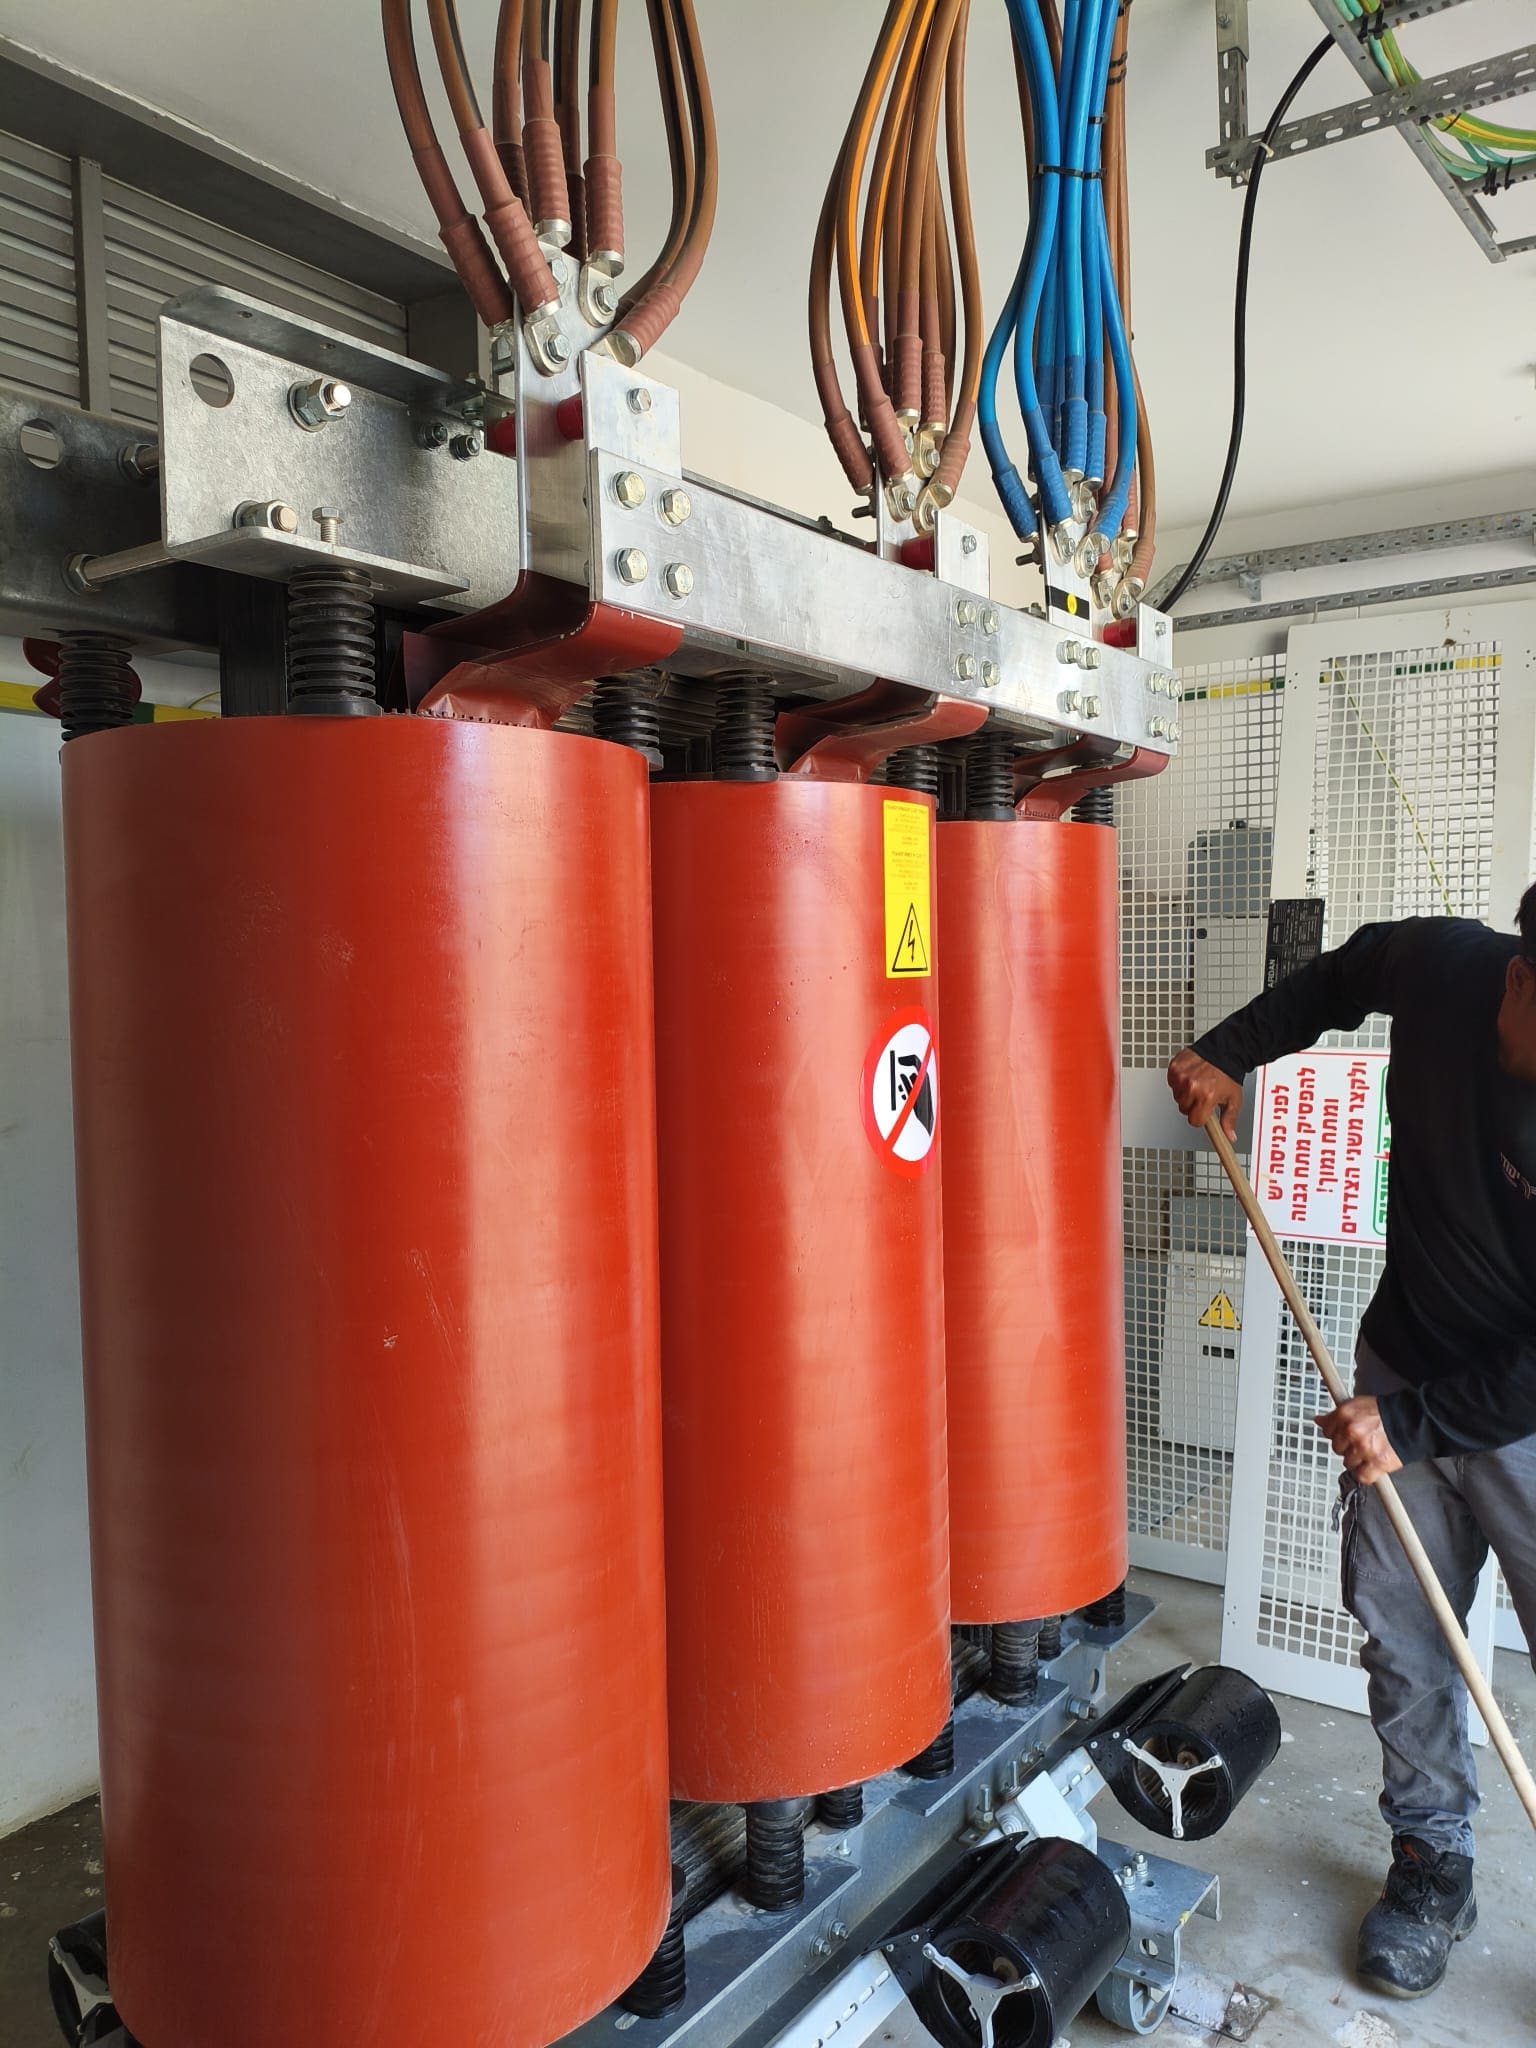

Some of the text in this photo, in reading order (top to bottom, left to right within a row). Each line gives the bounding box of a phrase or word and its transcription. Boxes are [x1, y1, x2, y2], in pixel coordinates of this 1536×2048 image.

[1267, 959, 1275, 988] ARDAN
[1267, 1084, 1290, 1200] לפני כניסה יש
[1290, 1066, 1316, 1222] להפסיק מתח גבוה
[1316, 1098, 1339, 1193] ומתח נמוך!
[1340, 1061, 1370, 1234] ולקצר משני הצדדים
